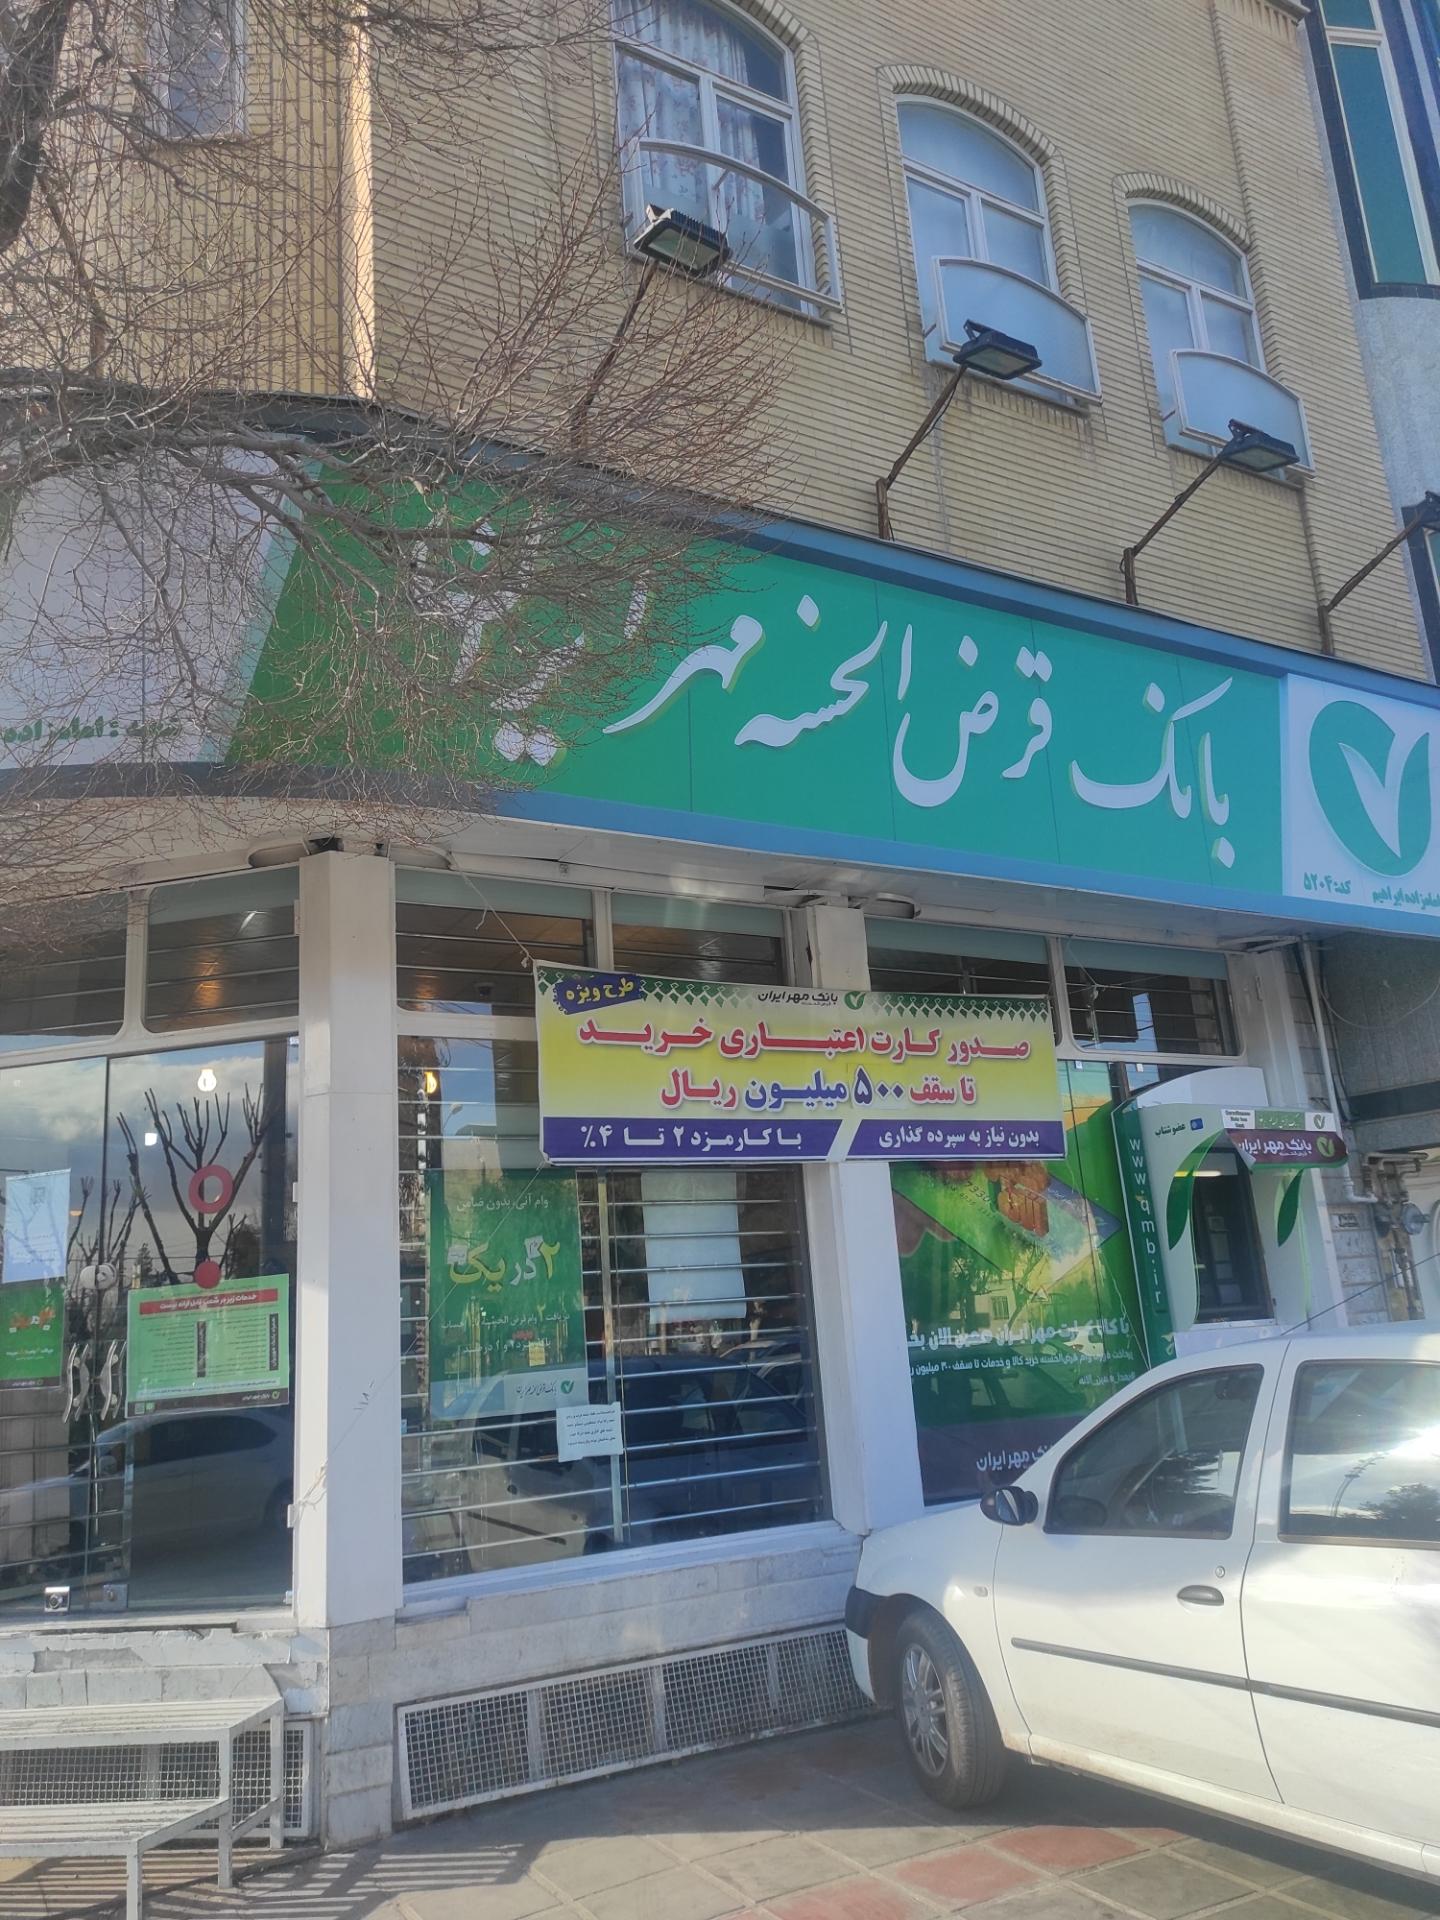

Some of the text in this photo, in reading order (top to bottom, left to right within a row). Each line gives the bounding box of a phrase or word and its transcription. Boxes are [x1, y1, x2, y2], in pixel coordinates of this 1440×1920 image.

[602, 614, 763, 734] مهر
[734, 594, 913, 748] الحسنه
[893, 635, 1053, 807] قرض
[1071, 677, 1236, 868] بانک
[565, 977, 634, 1004] طرح ویژه
[757, 990, 838, 1005] بانک مهر ایران
[579, 1018, 1030, 1063] صدور کارت اعتباری خرید
[660, 1067, 976, 1108] تا سقف ۵۰۰ میلیون ریال
[623, 1127, 665, 1146] تا
[672, 1125, 684, 1147] ۲
[690, 1127, 772, 1152] کارمزد
[777, 1127, 802, 1150] با
[878, 1126, 1040, 1149] بدون نیاز به سپرده گذاری
[1155, 1123, 1186, 1137] عضو شتاب
[1264, 1138, 1285, 1155] مهر
[1286, 1137, 1313, 1155] بانک
[1129, 1138, 1162, 1304] www.qmb.ir
[450, 1241, 506, 1292] یک
[510, 1257, 537, 1286] در
[539, 1241, 560, 1279] ۲
[1119, 1317, 1130, 1337] با
[976, 1449, 1006, 1472] ایران
[1007, 1450, 1030, 1470] مهر
